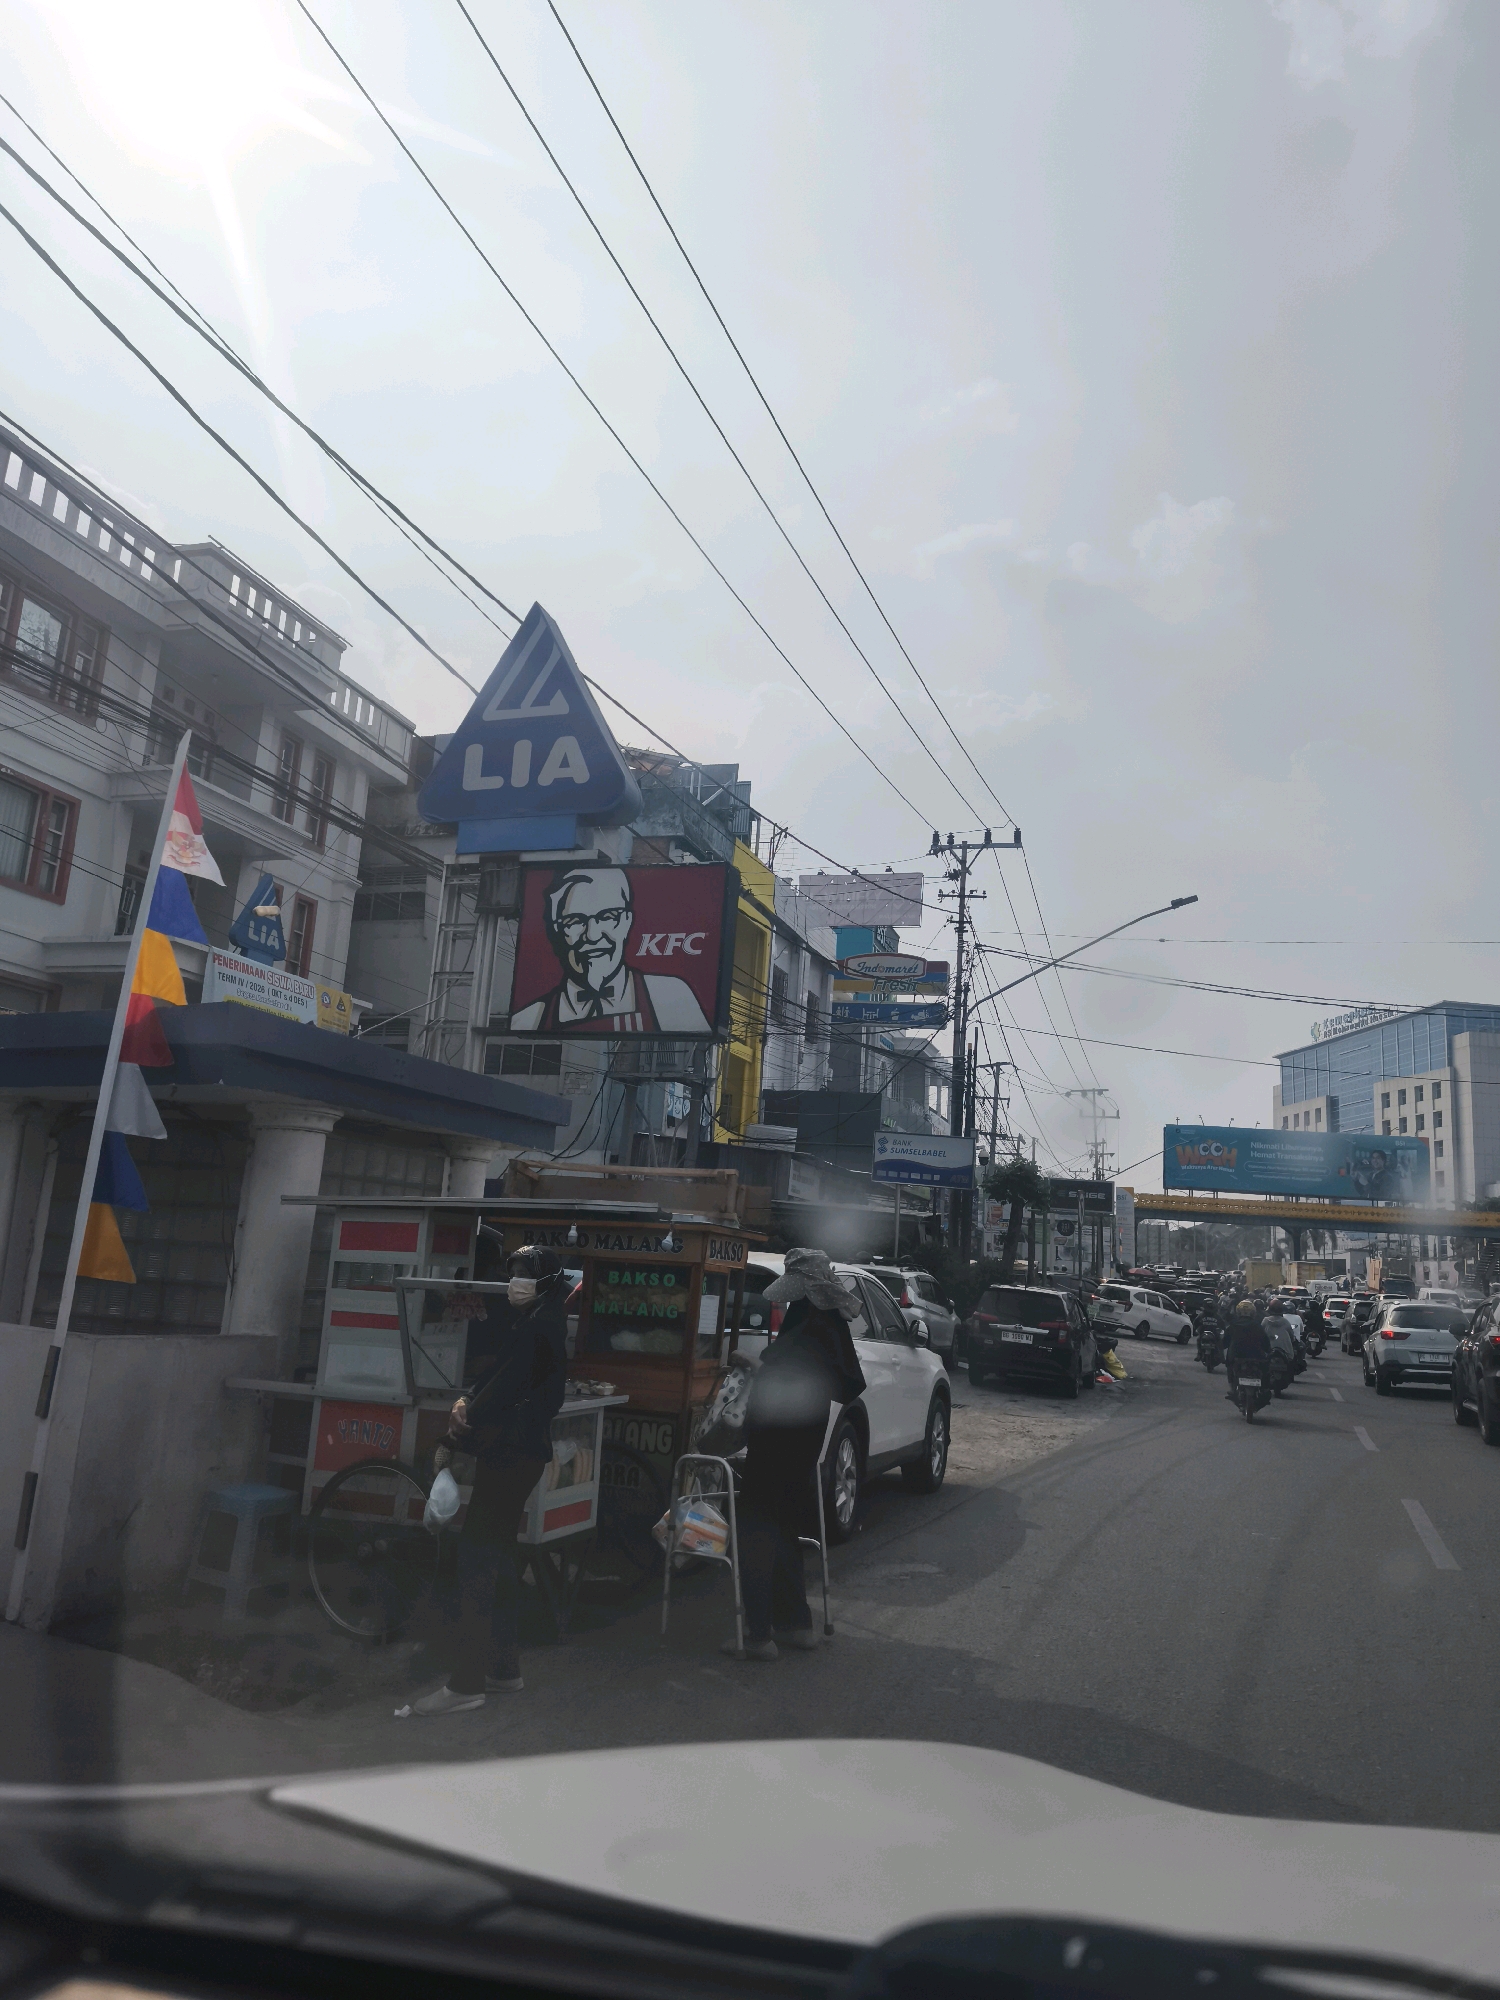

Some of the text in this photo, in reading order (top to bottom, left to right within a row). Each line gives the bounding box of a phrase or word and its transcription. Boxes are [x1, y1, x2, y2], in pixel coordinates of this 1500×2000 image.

[462, 736, 591, 791] LIA
[248, 920, 280, 950] LIA
[636, 932, 706, 956] KFC
[857, 961, 918, 974] Indomaret
[213, 953, 315, 999] PENERIMAAN SISWA BARU
[218, 972, 237, 985] TERM
[872, 977, 917, 992] Fresh
[893, 1139, 912, 1147] BANK
[1251, 1142, 1280, 1150] Nikmati
[890, 1147, 947, 1158] SUMSELBABEL
[1251, 1151, 1276, 1159] Hemat
[709, 1239, 744, 1263] BAKSO
[608, 1271, 676, 1287] BAKSO
[593, 1301, 678, 1319] MALANG
[337, 1418, 396, 1450] YANTO
